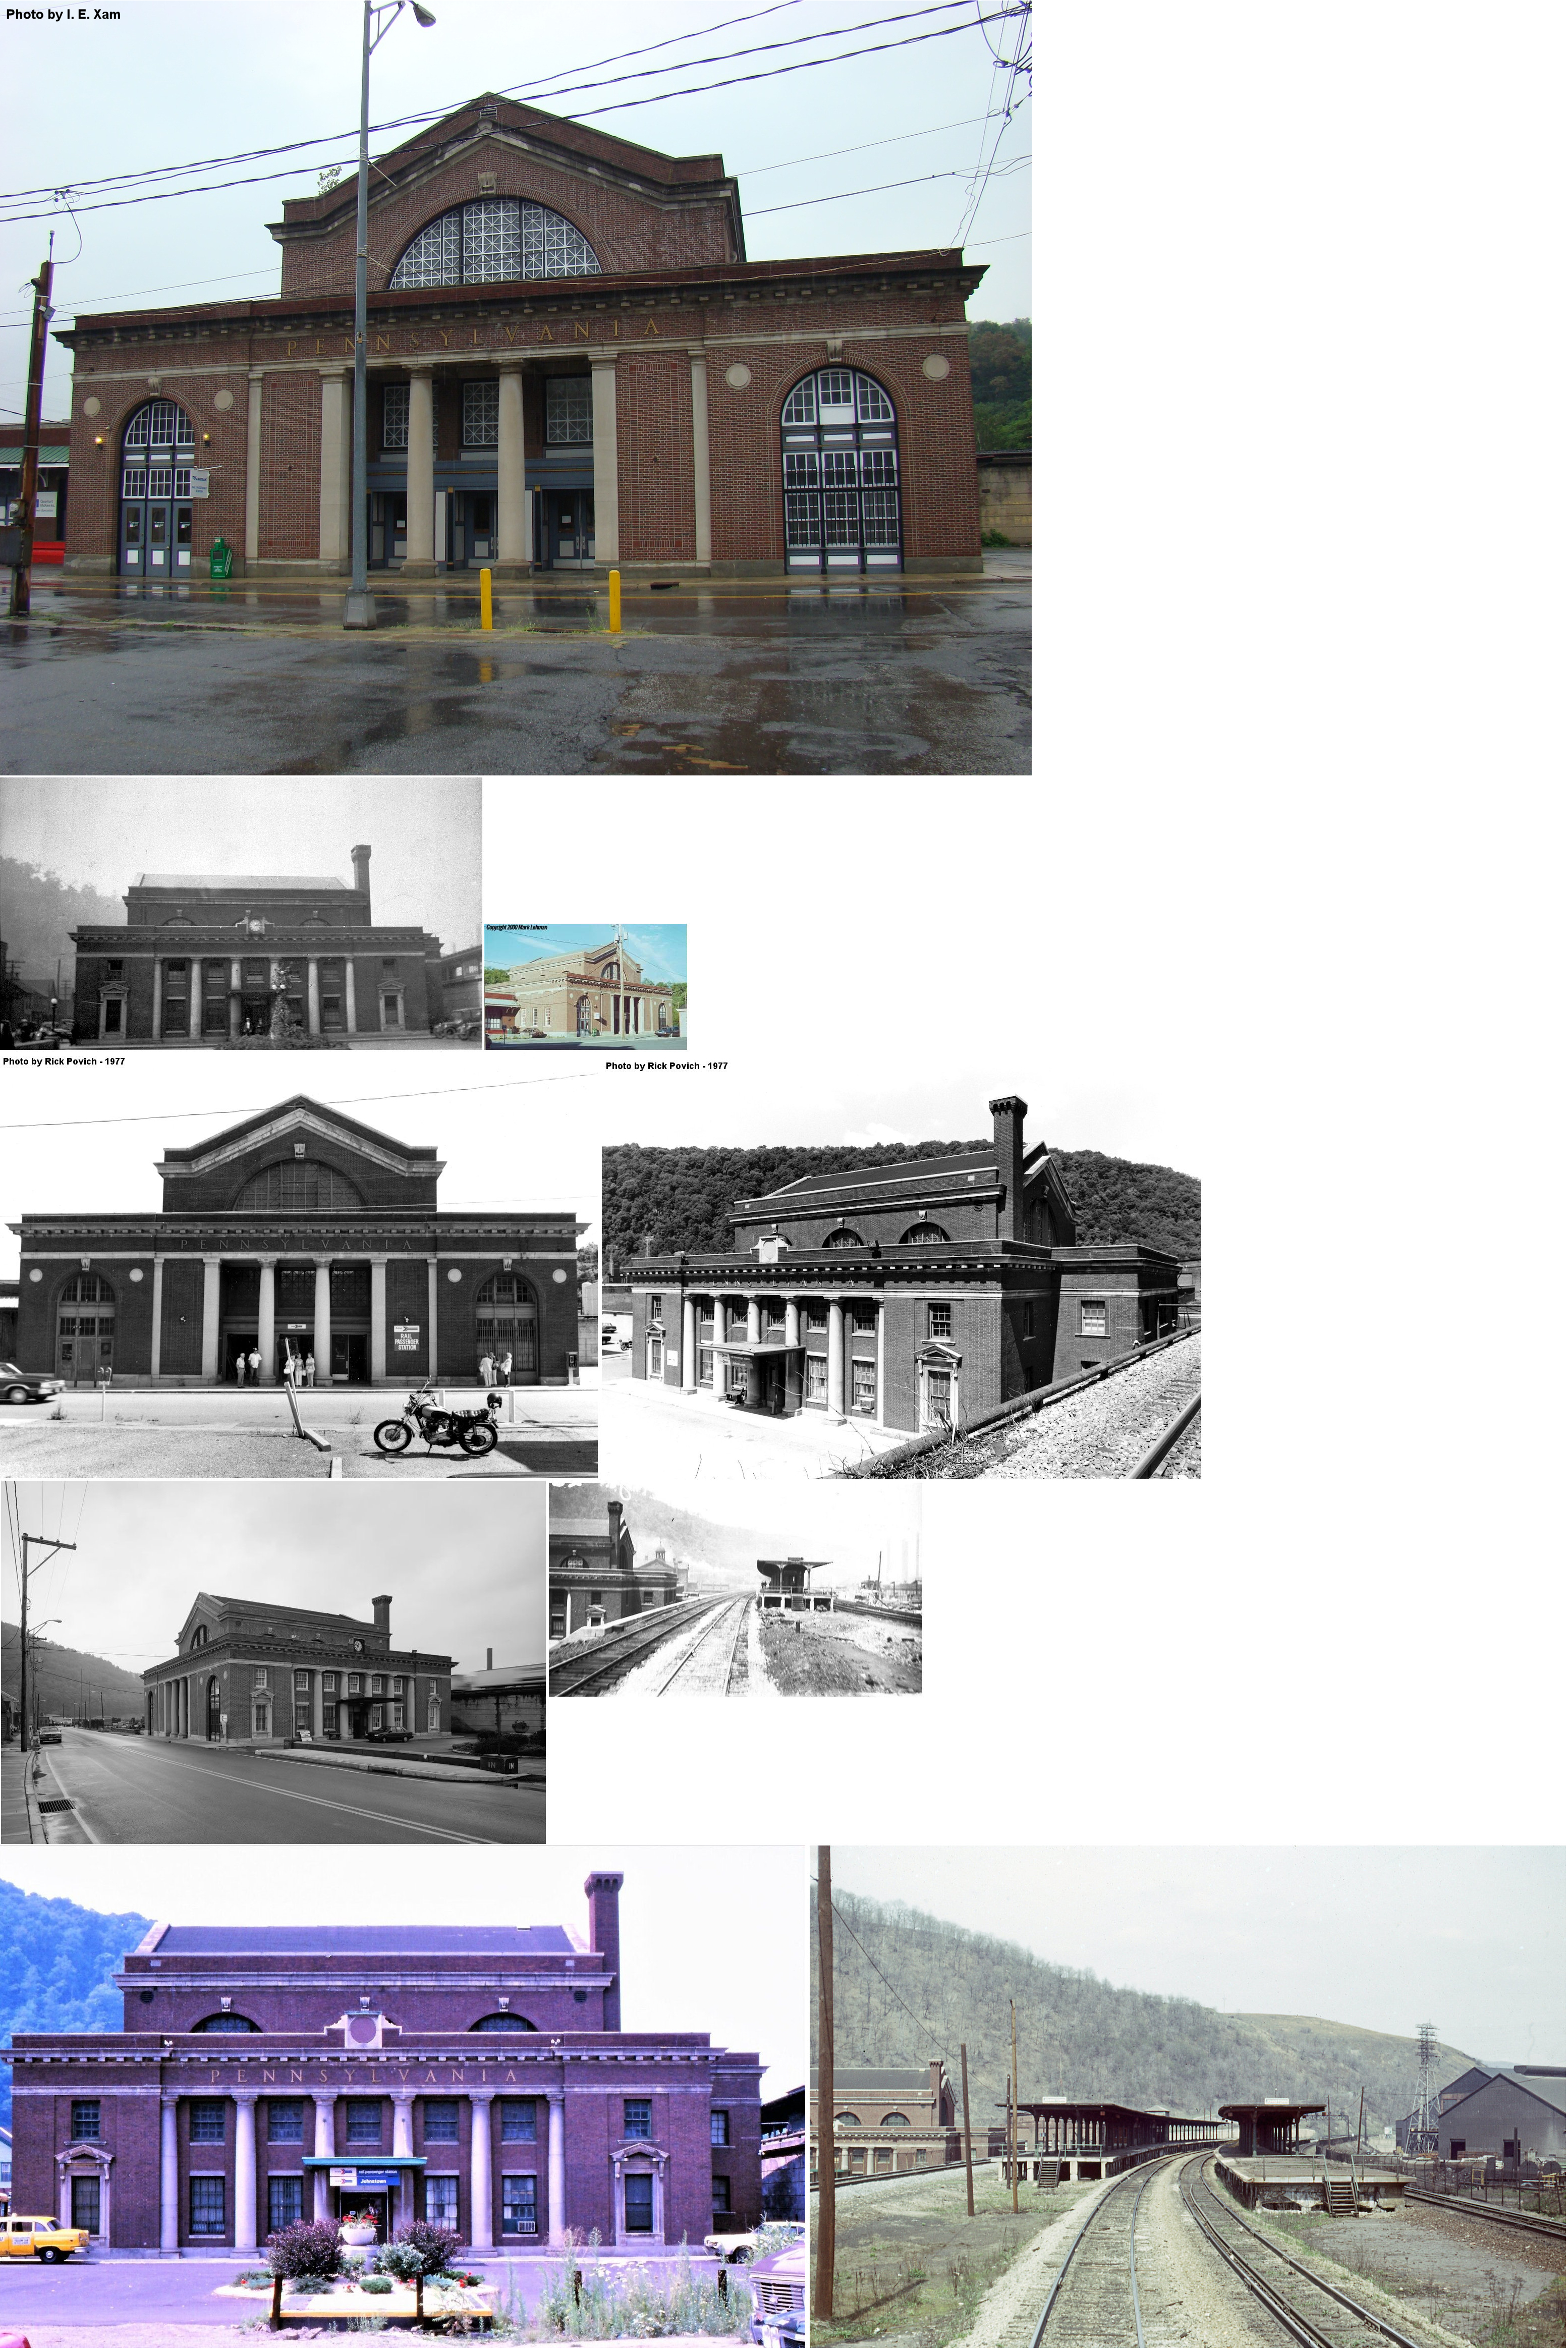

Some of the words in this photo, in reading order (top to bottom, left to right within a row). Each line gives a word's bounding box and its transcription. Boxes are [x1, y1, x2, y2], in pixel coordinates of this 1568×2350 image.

[287, 318, 661, 356] PENNSYLVANIA
[181, 1239, 412, 1250] PENNSYLVANIA
[702, 1276, 856, 1287] PENNSYLVANIA
[211, 2069, 517, 2083] PENNSYLVANIA
